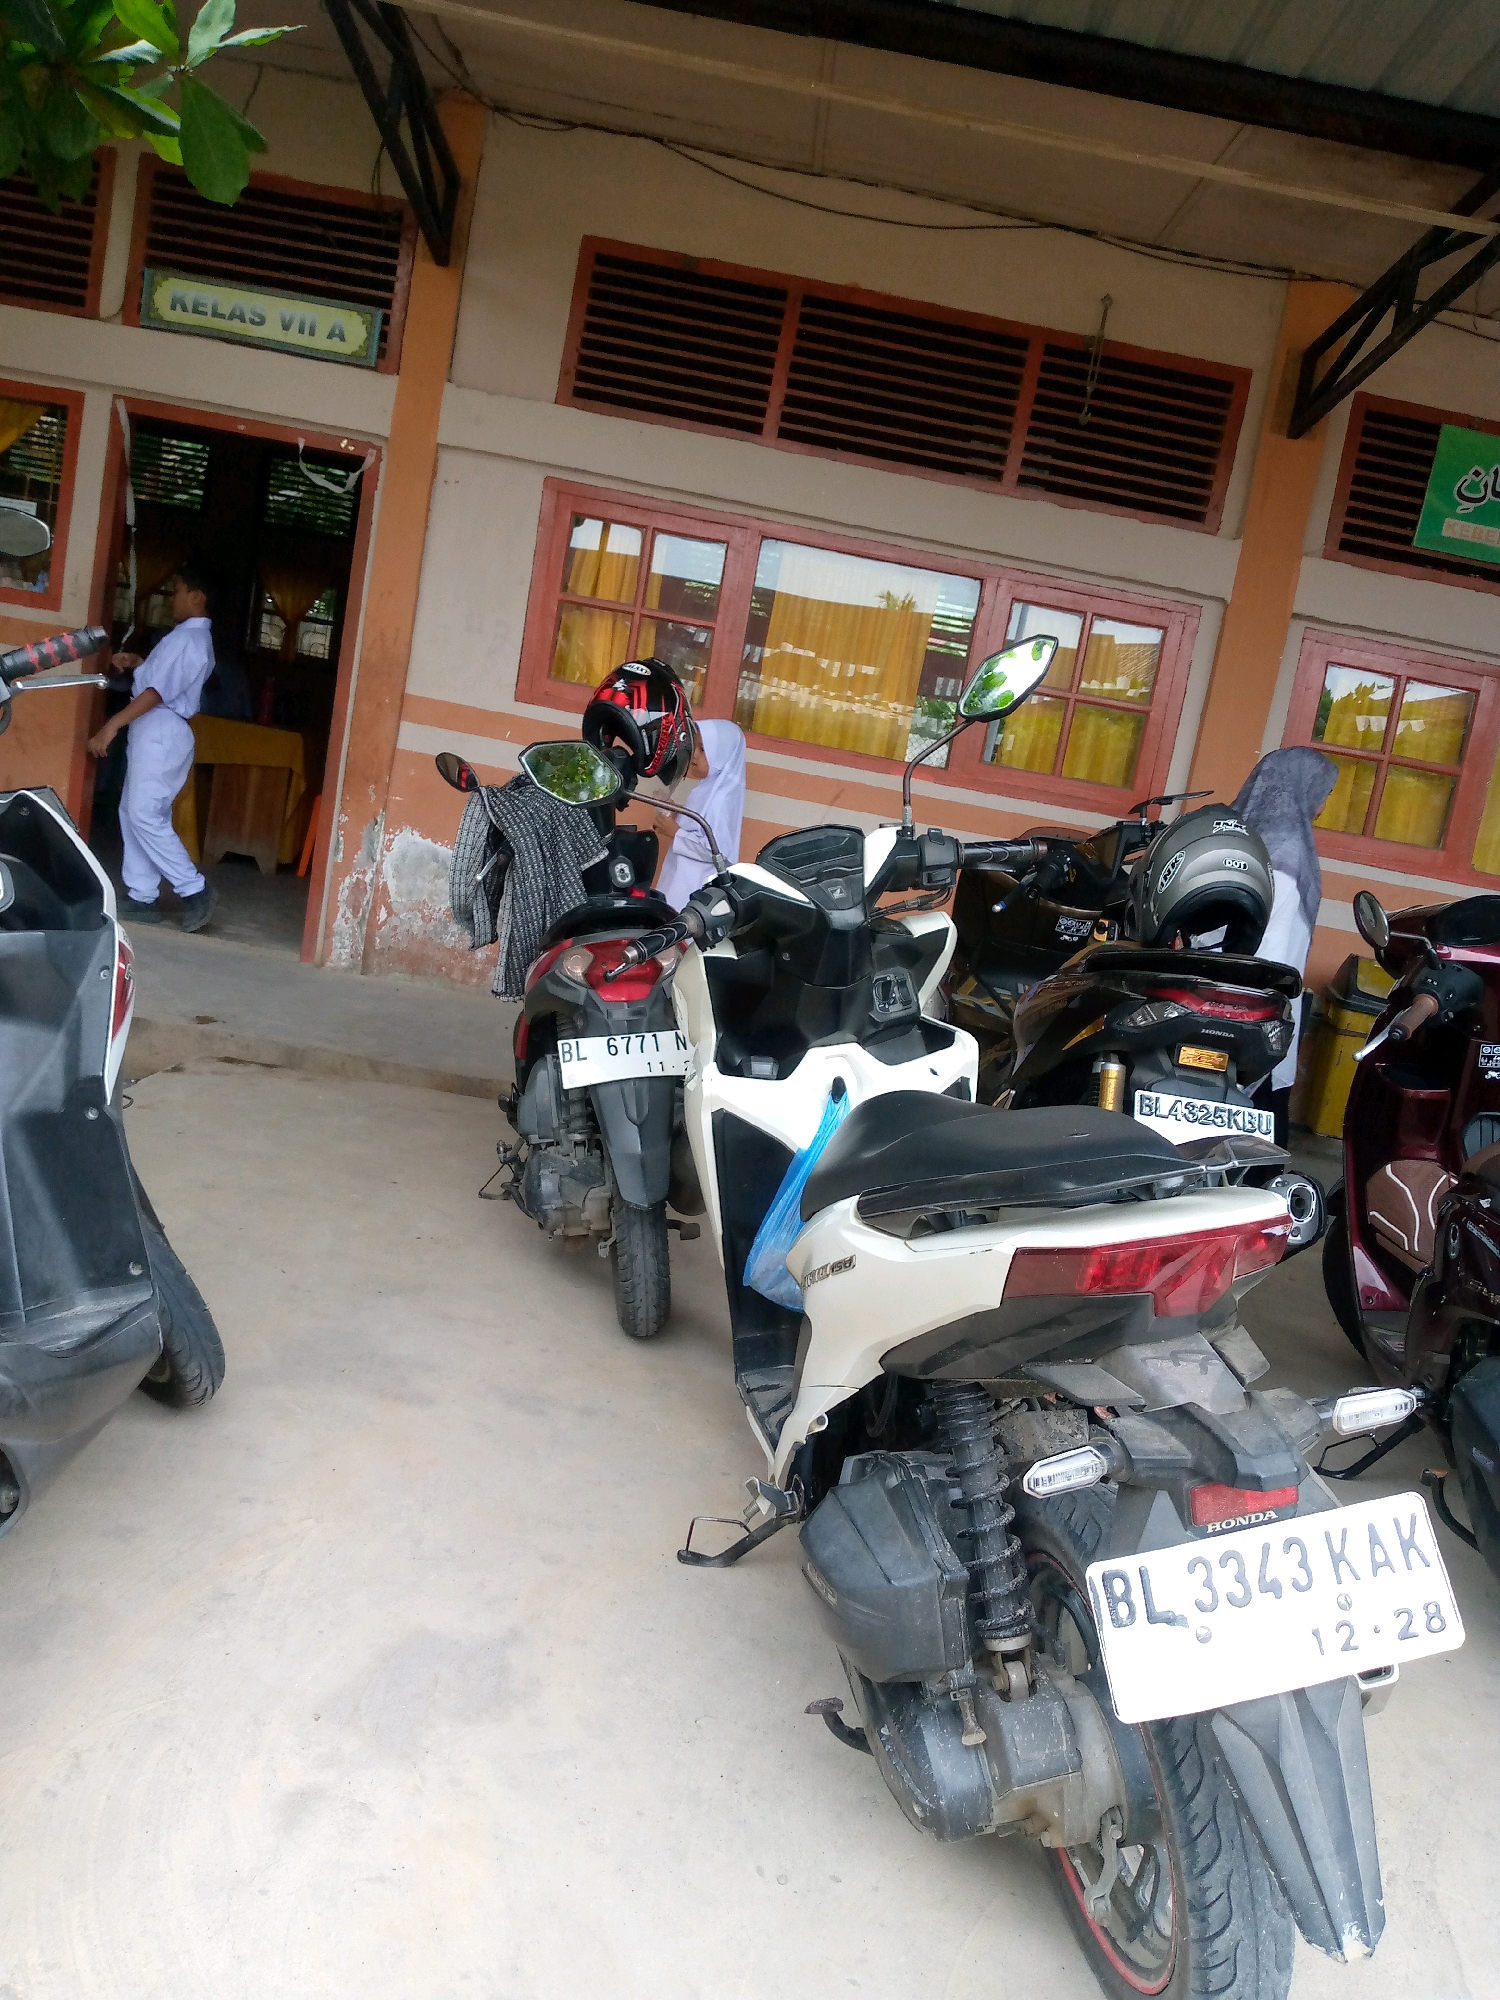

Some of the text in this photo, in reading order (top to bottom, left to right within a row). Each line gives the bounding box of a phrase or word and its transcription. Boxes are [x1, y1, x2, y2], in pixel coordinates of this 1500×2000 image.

[170, 287, 347, 343] KELAS VII A
[1446, 519, 1500, 546] KEBE
[1159, 853, 1184, 892] INK
[1224, 858, 1248, 871] DOT
[1201, 1028, 1235, 1039] HONDA
[561, 1040, 588, 1064] BL
[606, 1033, 660, 1057] 6771
[1205, 1508, 1279, 1534] HONDA
[1102, 1512, 1431, 1628] BL 3343 KAK
